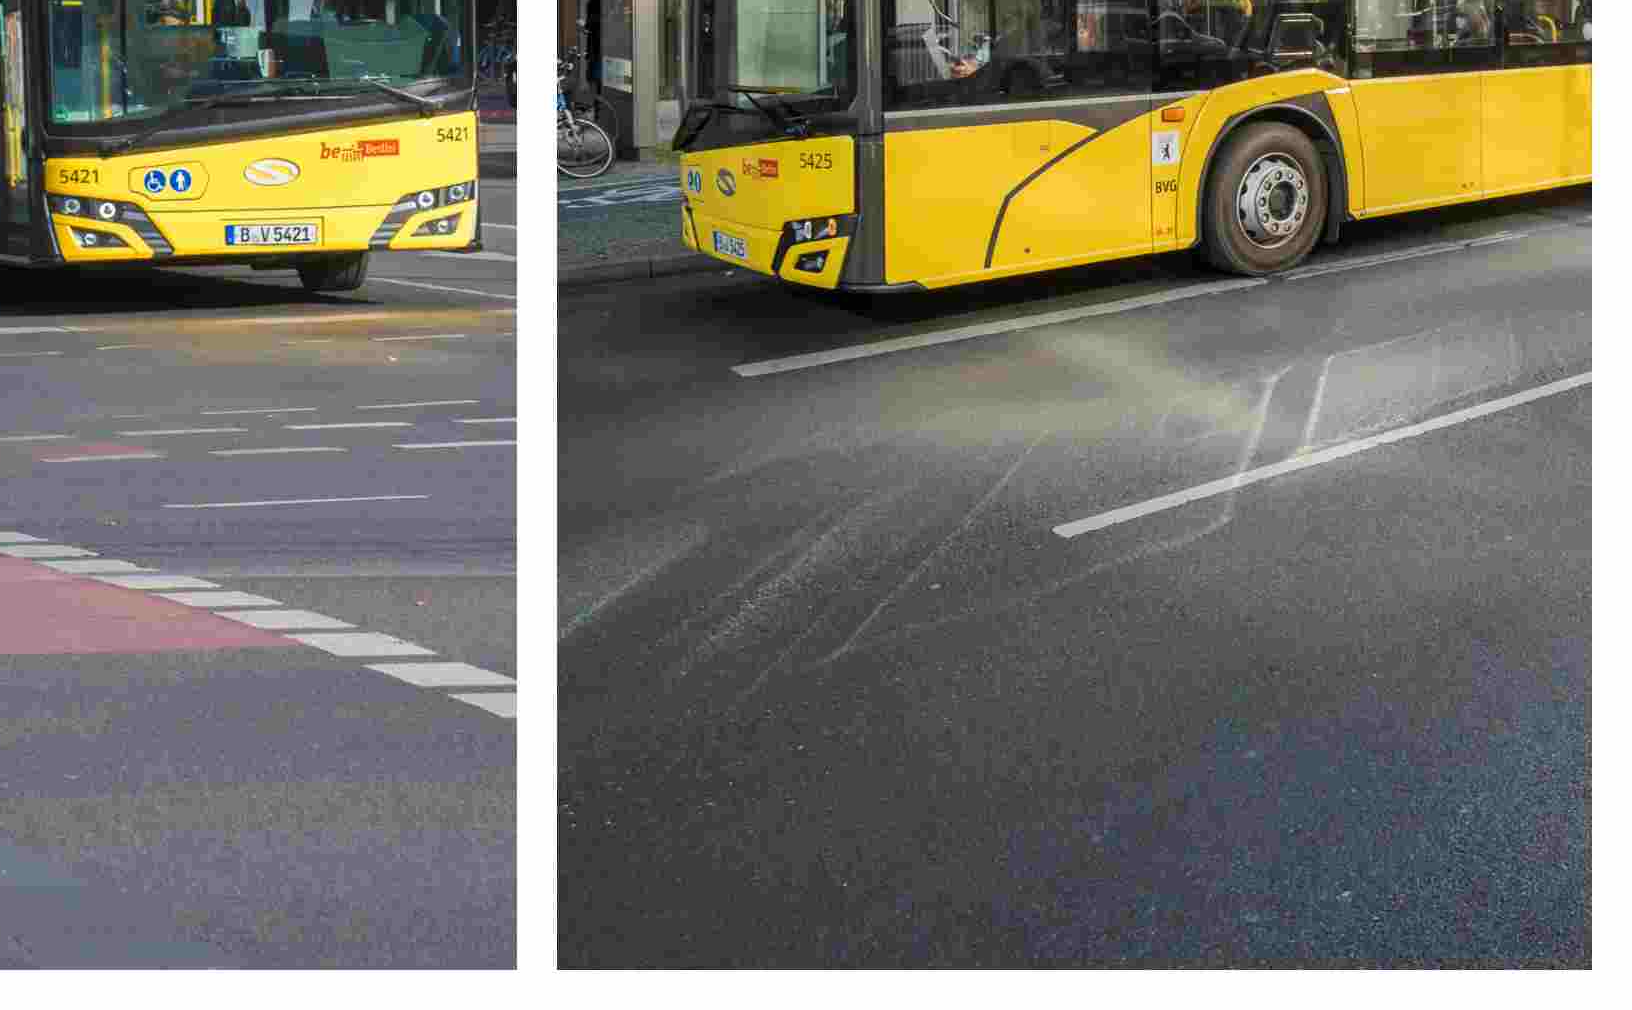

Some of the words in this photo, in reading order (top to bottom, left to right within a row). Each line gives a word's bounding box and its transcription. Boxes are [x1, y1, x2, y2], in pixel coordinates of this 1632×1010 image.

[436, 126, 470, 142] 5421
[799, 152, 833, 170] 5425
[59, 169, 99, 184] 5421
[1155, 179, 1177, 194] BVG
[240, 227, 251, 242] B
[260, 227, 271, 242] V
[273, 226, 311, 242] 5421
